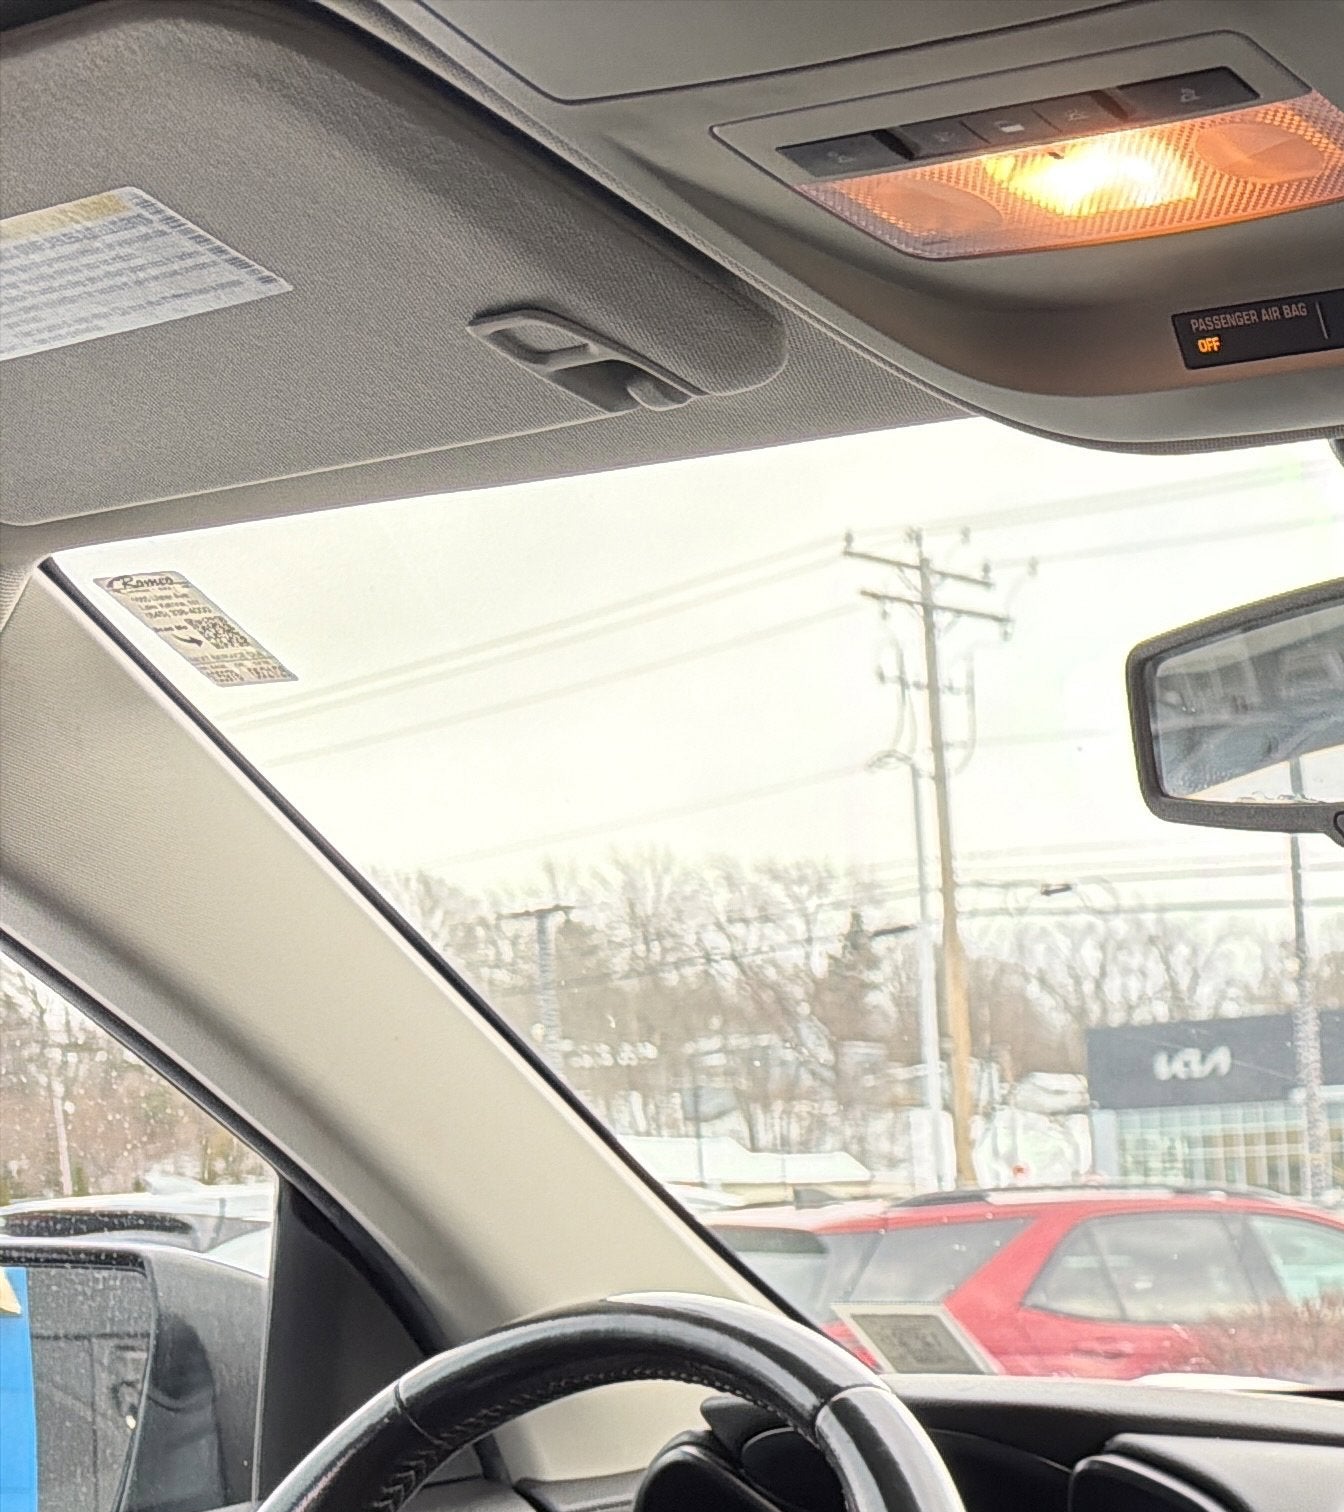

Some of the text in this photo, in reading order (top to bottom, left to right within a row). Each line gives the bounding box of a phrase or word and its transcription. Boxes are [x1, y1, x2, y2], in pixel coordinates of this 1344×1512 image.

[1191, 302, 1307, 333] PASSENGER AIR BAG
[1198, 337, 1221, 353] OFF
